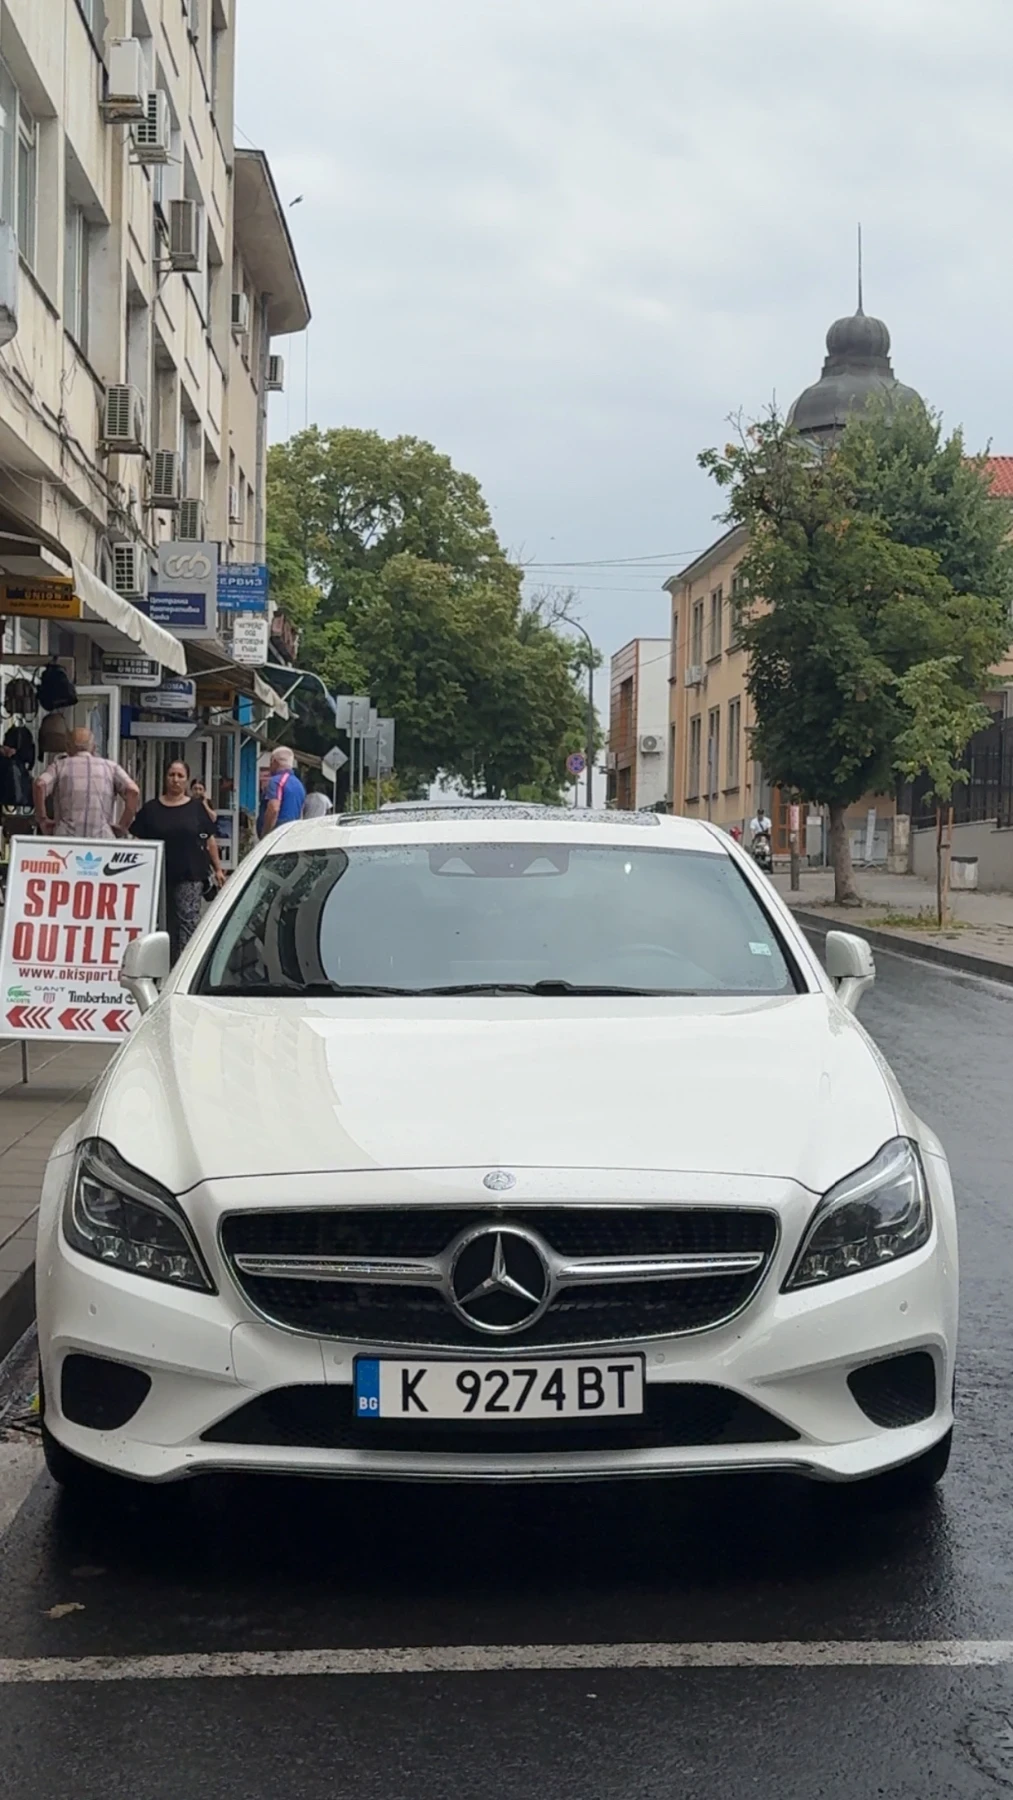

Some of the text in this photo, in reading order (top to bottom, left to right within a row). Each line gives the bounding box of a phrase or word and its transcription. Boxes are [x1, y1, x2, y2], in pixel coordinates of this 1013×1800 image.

[217, 577, 262, 587] ЕРВИЗ
[104, 659, 149, 667] WESTERN
[117, 666, 149, 674] UNION
[20, 859, 60, 875] PUMA
[111, 851, 139, 864] NIKE
[24, 878, 141, 921] SPORT
[34, 985, 66, 993] GANT
[68, 990, 123, 1004] Timberland
[359, 1396, 378, 1411] BG
[401, 1368, 429, 1413] K
